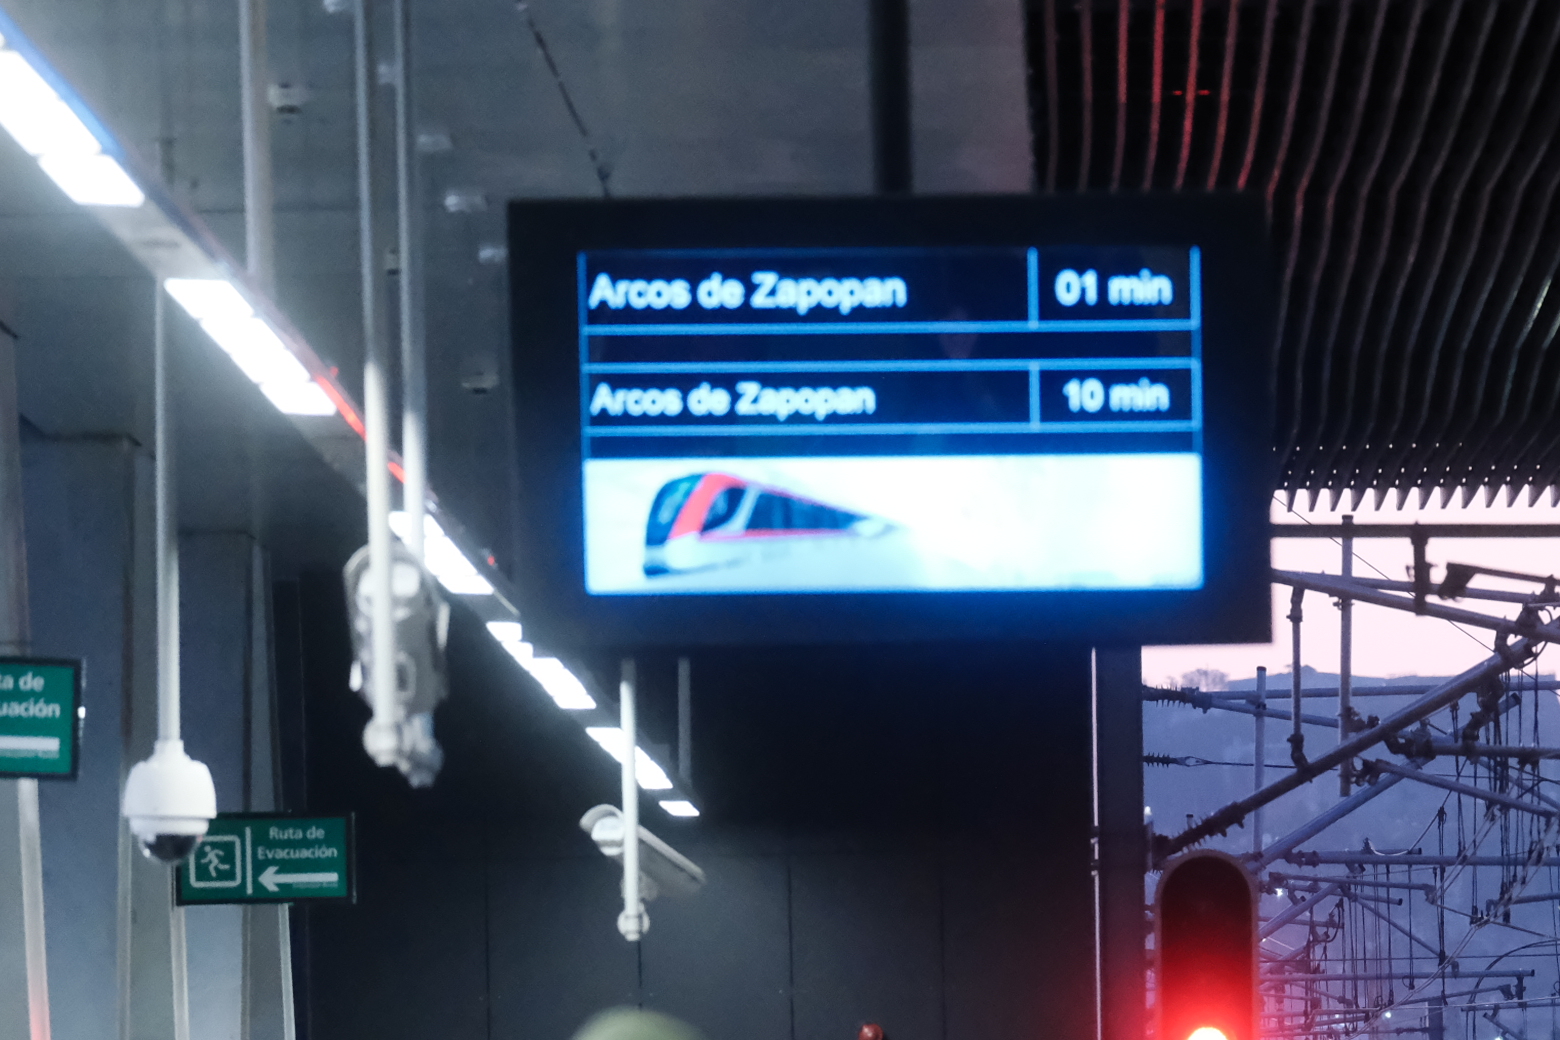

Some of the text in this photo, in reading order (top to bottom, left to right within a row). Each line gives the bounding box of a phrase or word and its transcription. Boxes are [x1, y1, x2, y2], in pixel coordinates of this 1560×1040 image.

[588, 270, 907, 315] Arcos de Zapopan
[1055, 268, 1173, 307] 01 min
[589, 380, 876, 422] Arcos de Zapopan
[1062, 377, 1170, 414] 10 min
[19, 671, 45, 692] de
[269, 825, 325, 840] Ruta de
[257, 843, 338, 860] Evacuación
